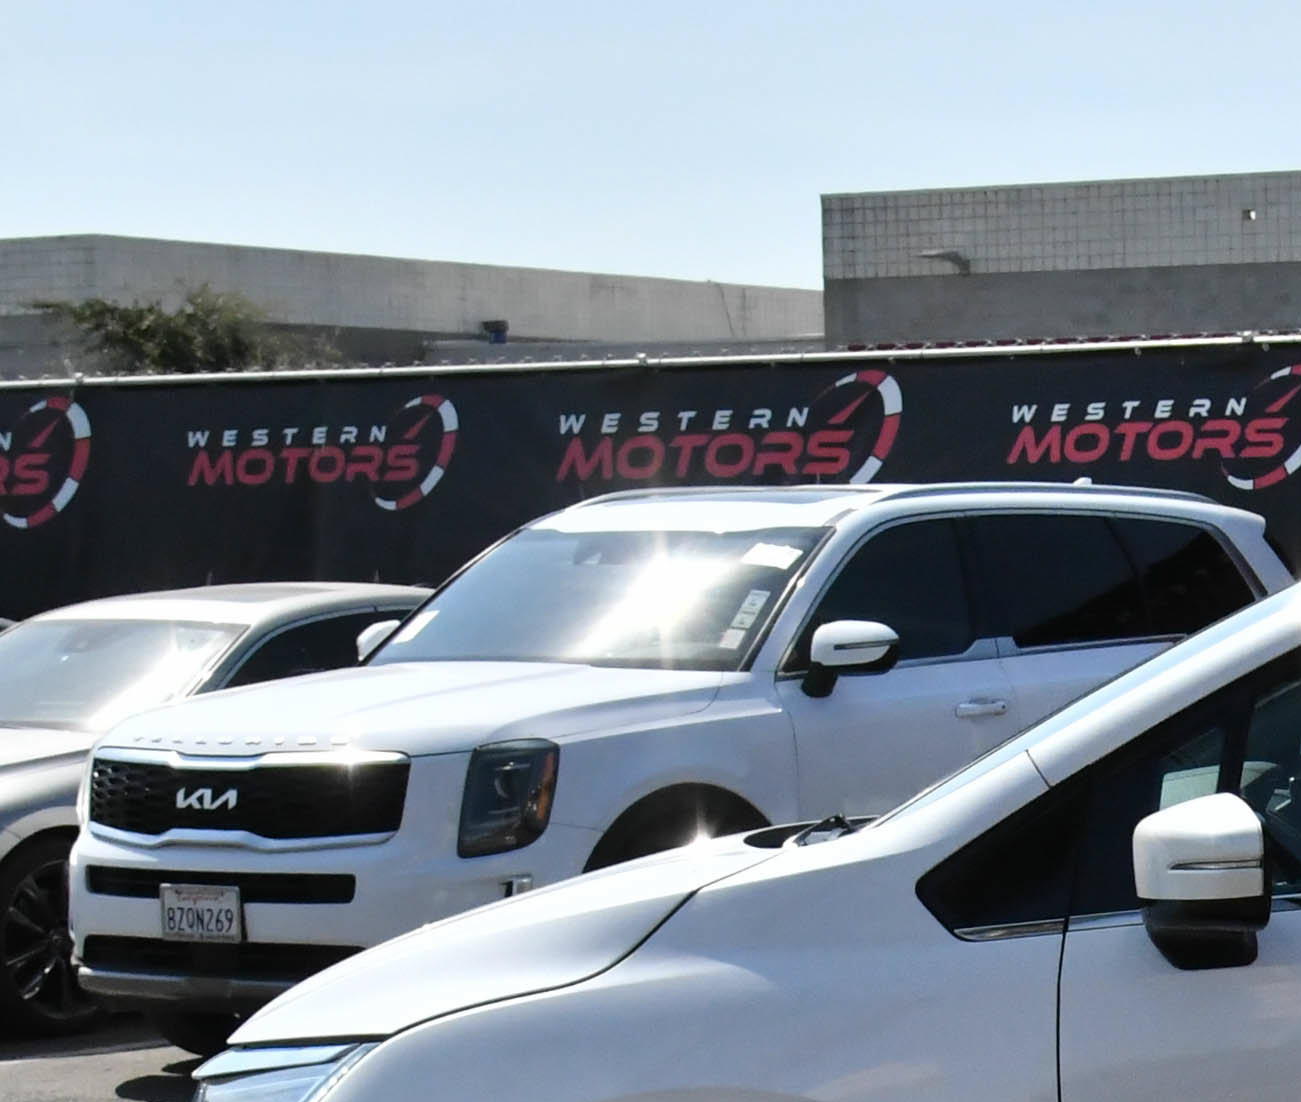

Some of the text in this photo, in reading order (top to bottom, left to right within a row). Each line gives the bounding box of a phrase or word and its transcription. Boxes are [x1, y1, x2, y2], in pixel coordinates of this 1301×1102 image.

[559, 407, 809, 435] WESTERN
[1012, 397, 1248, 424] WESTERN
[187, 425, 388, 448] WESTERN
[1006, 418, 1290, 464] MOTORS
[187, 444, 421, 487] MOTORS
[556, 429, 854, 482] MOTORS
[176, 787, 238, 810] KIA
